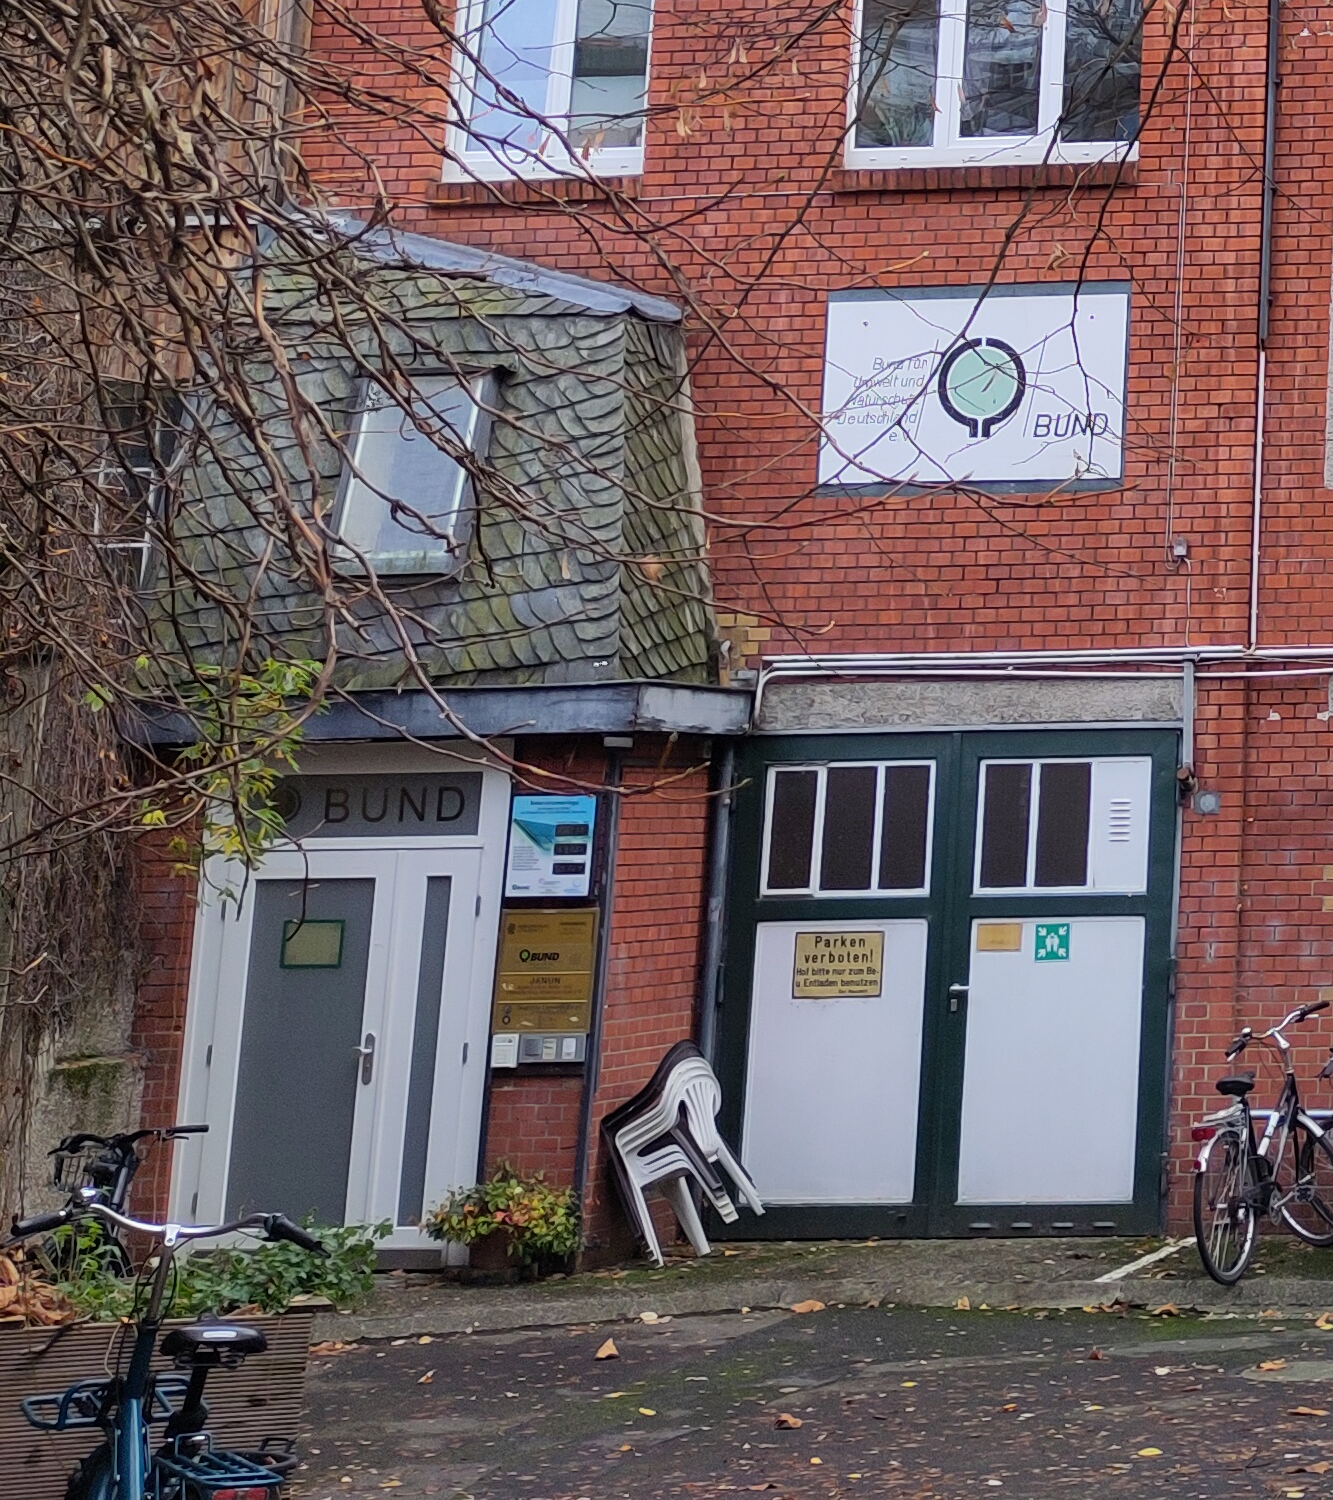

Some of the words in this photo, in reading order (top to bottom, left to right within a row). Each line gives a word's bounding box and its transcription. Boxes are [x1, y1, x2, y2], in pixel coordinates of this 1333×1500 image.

[900, 374, 925, 388] und
[851, 392, 919, 406] aturschu
[1032, 412, 1109, 438] BUND
[324, 786, 466, 824] BUND
[814, 935, 866, 949] Parken
[530, 952, 560, 962] BUND
[804, 948, 874, 964] verboten!
[796, 967, 810, 976] Hof
[811, 967, 831, 976] bitte
[832, 968, 847, 976] nur
[848, 968, 865, 976] zum
[803, 978, 839, 988] Entladen
[840, 978, 879, 987] benutzen
